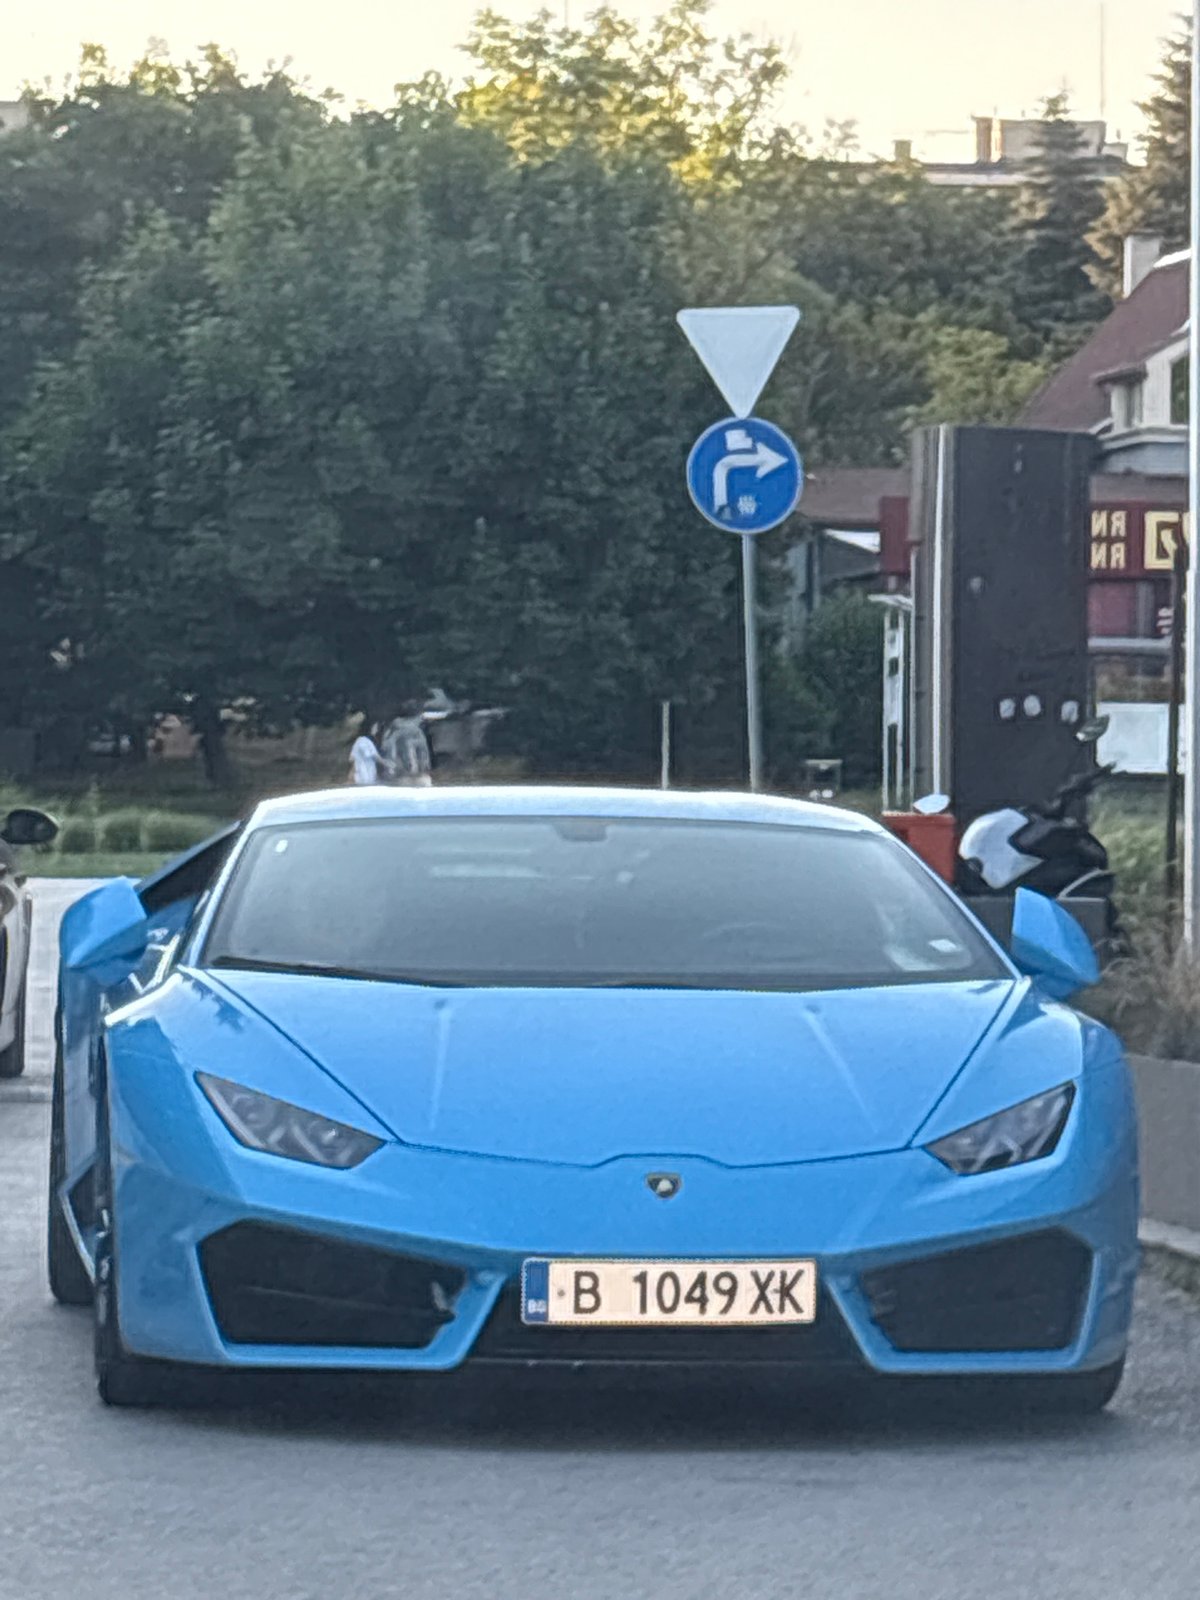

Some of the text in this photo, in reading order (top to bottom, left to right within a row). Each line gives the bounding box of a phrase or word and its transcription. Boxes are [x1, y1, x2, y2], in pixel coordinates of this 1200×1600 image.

[573, 1269, 804, 1315] B 1049 XK
